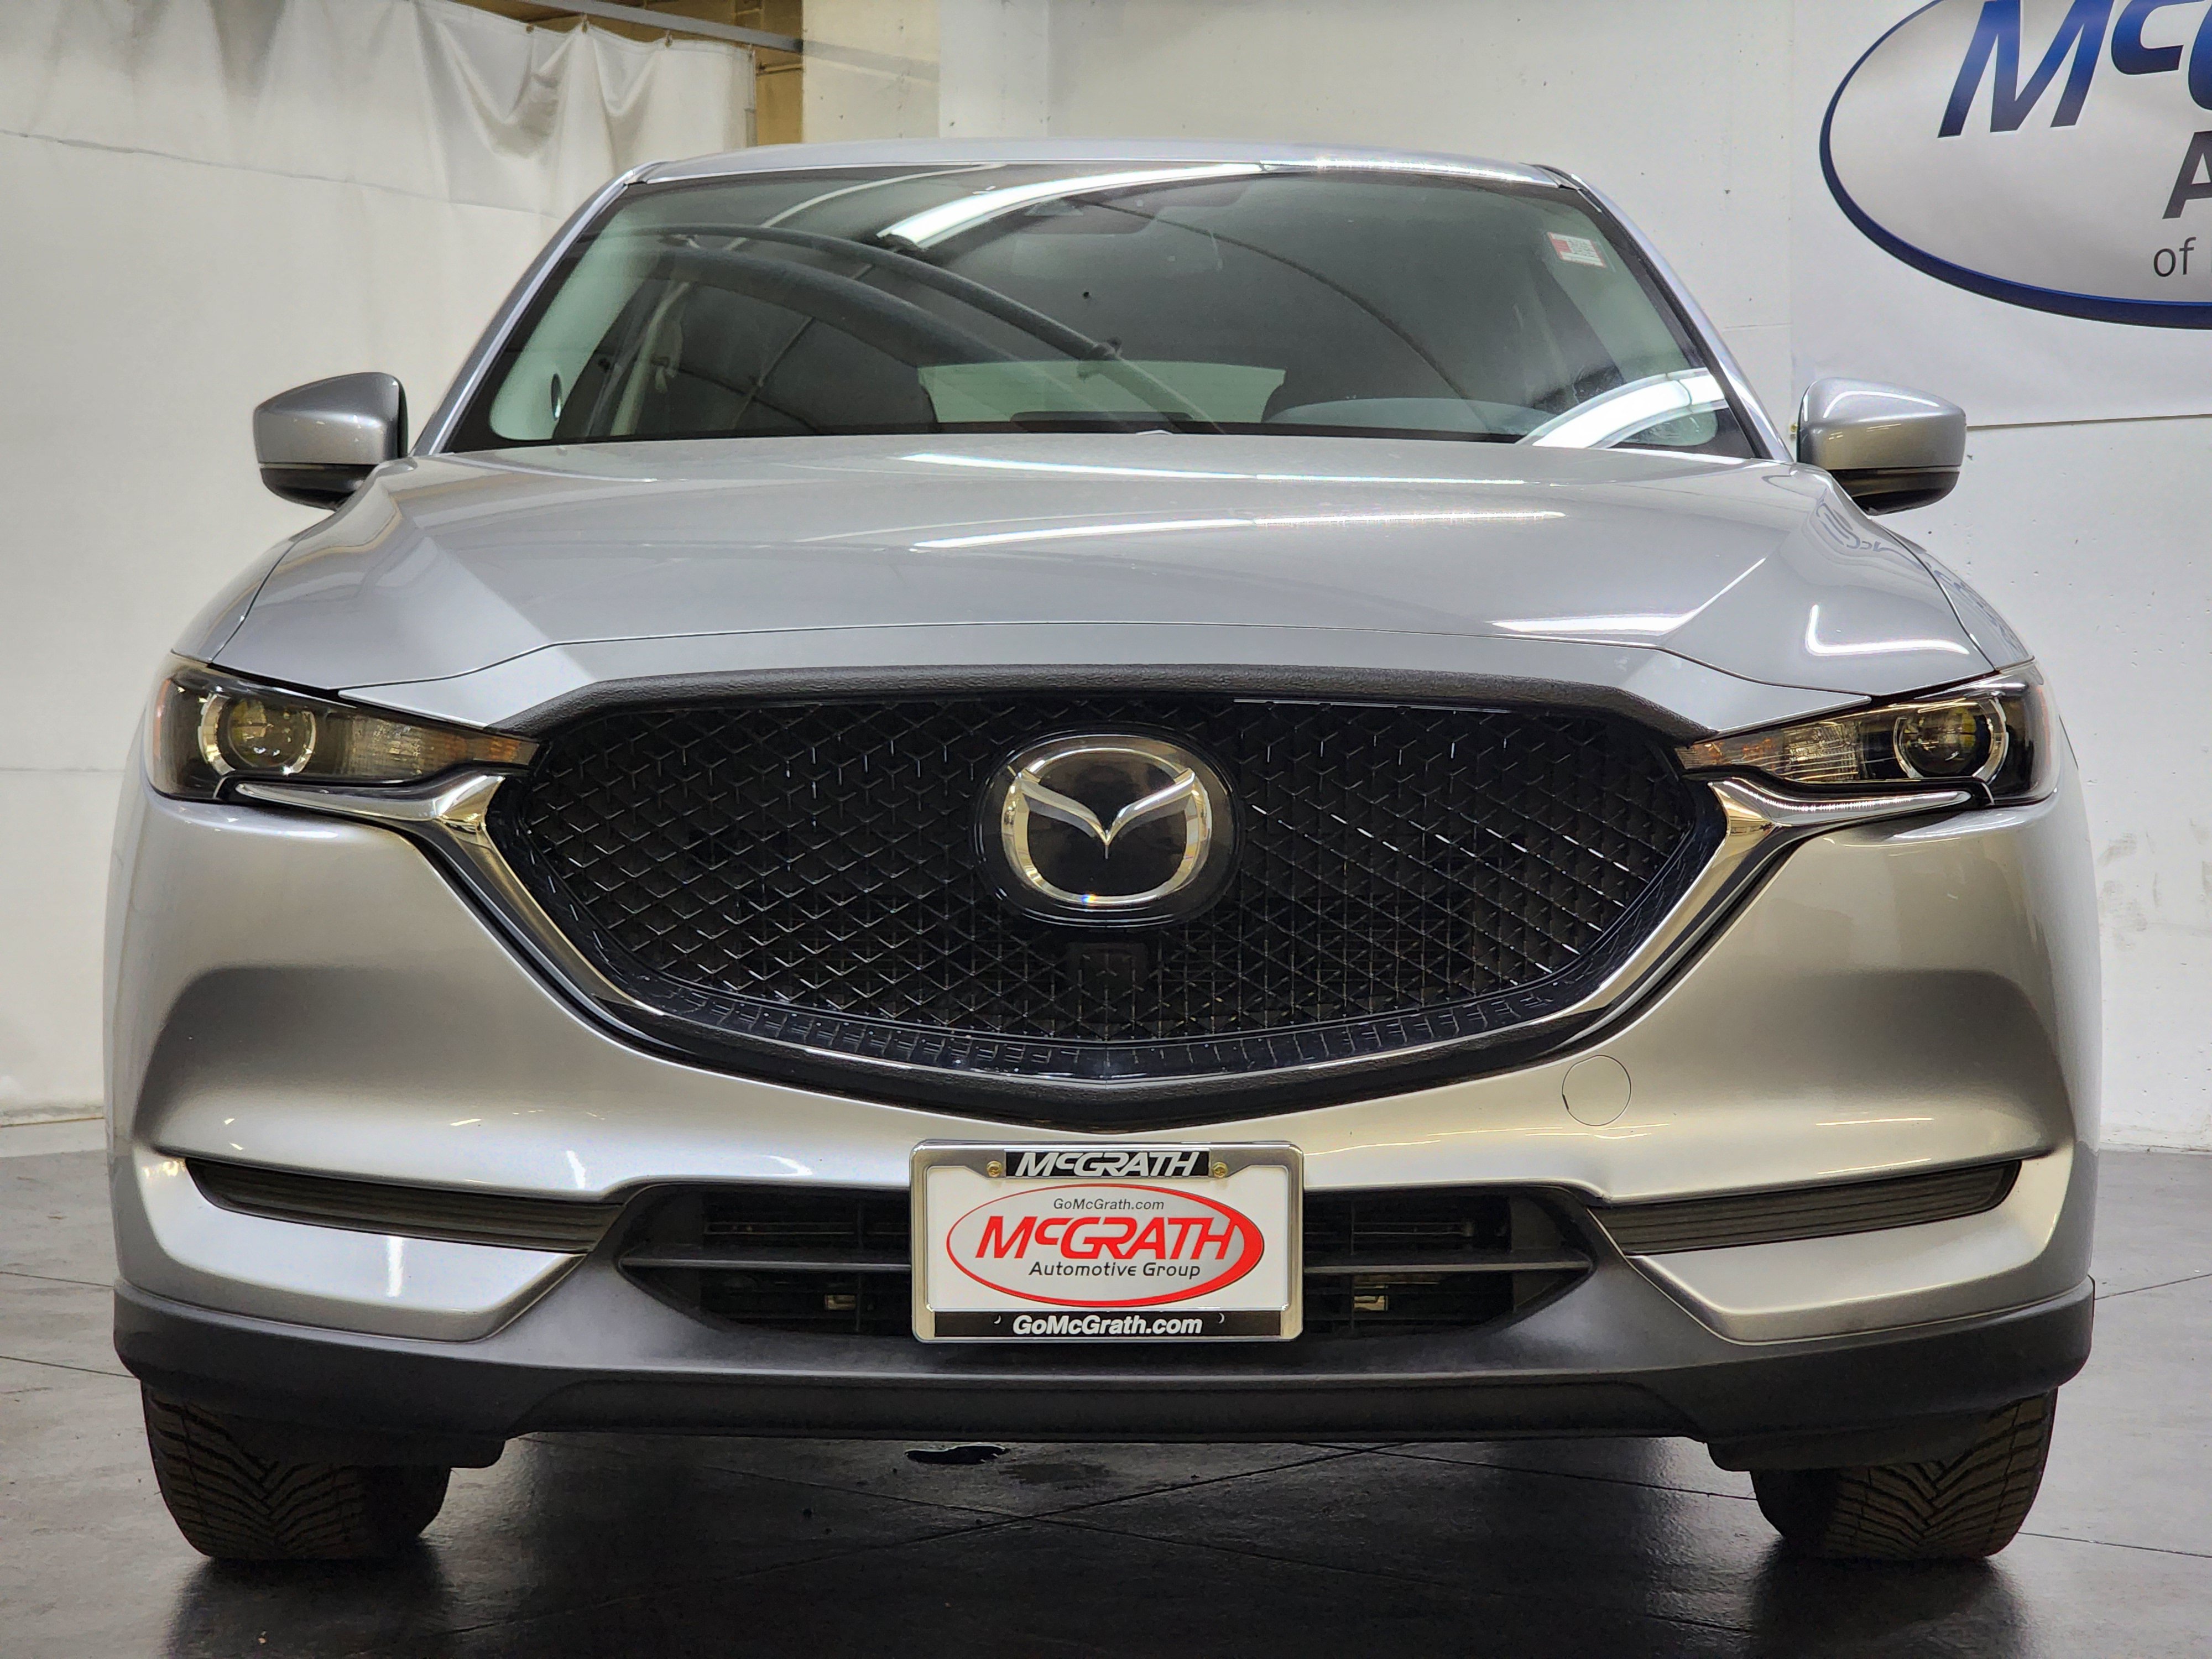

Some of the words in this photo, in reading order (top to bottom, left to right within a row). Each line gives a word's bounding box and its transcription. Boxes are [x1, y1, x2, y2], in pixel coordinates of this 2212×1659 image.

[2153, 237, 2197, 278] of
[1053, 1198, 1165, 1210] GoMcGrath.com
[1028, 1261, 1137, 1276] Automotive
[1142, 1262, 1201, 1280] Group
[1013, 1314, 1203, 1335] GoMcGrath.com
